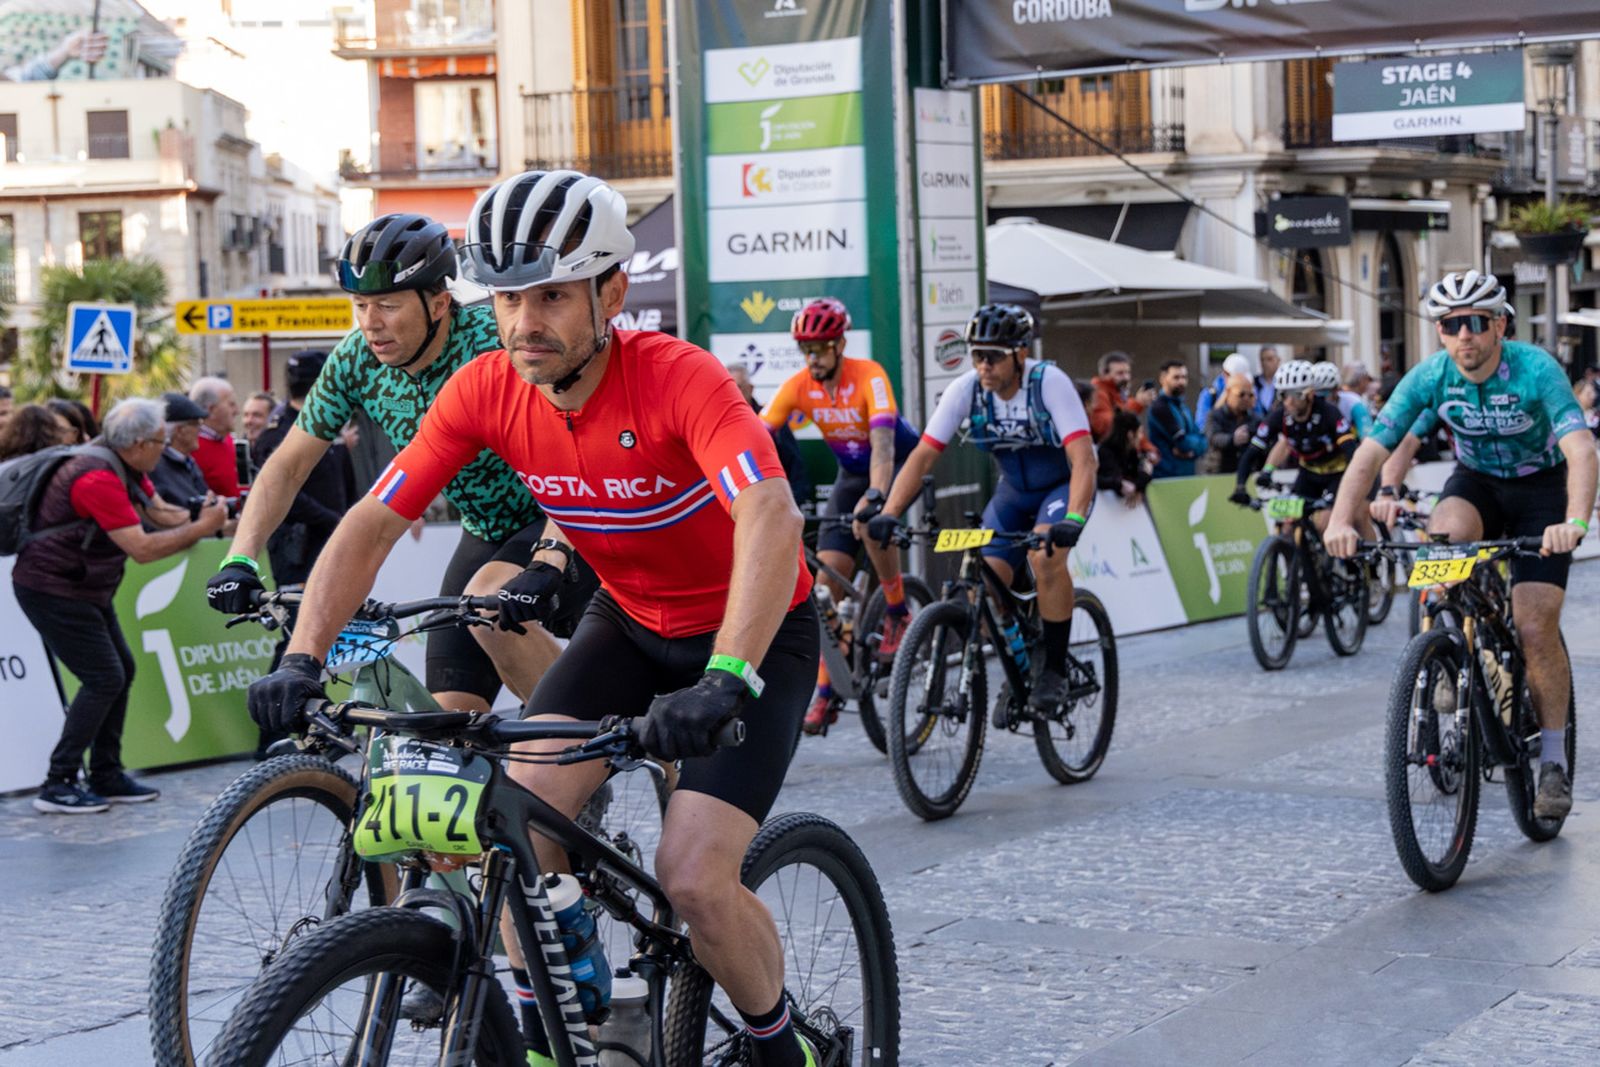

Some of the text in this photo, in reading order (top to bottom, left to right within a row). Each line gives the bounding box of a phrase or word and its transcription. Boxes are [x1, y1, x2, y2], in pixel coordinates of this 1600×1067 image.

[790, 74, 835, 86] Granada
[1381, 60, 1473, 85] STAGE 4
[1399, 83, 1456, 107] JAÉN
[1393, 115, 1463, 130] GARMIN
[921, 171, 971, 188] GARMIN
[727, 228, 848, 255] GARMIN
[212, 305, 231, 328] P
[239, 313, 350, 328] San Francisco
[516, 471, 677, 499] COSTA RICA
[942, 530, 986, 548] 317-1
[1416, 561, 1468, 581] 333-1
[188, 672, 217, 696] DE
[399, 759, 428, 770] RACE
[364, 782, 470, 843] 411-2
